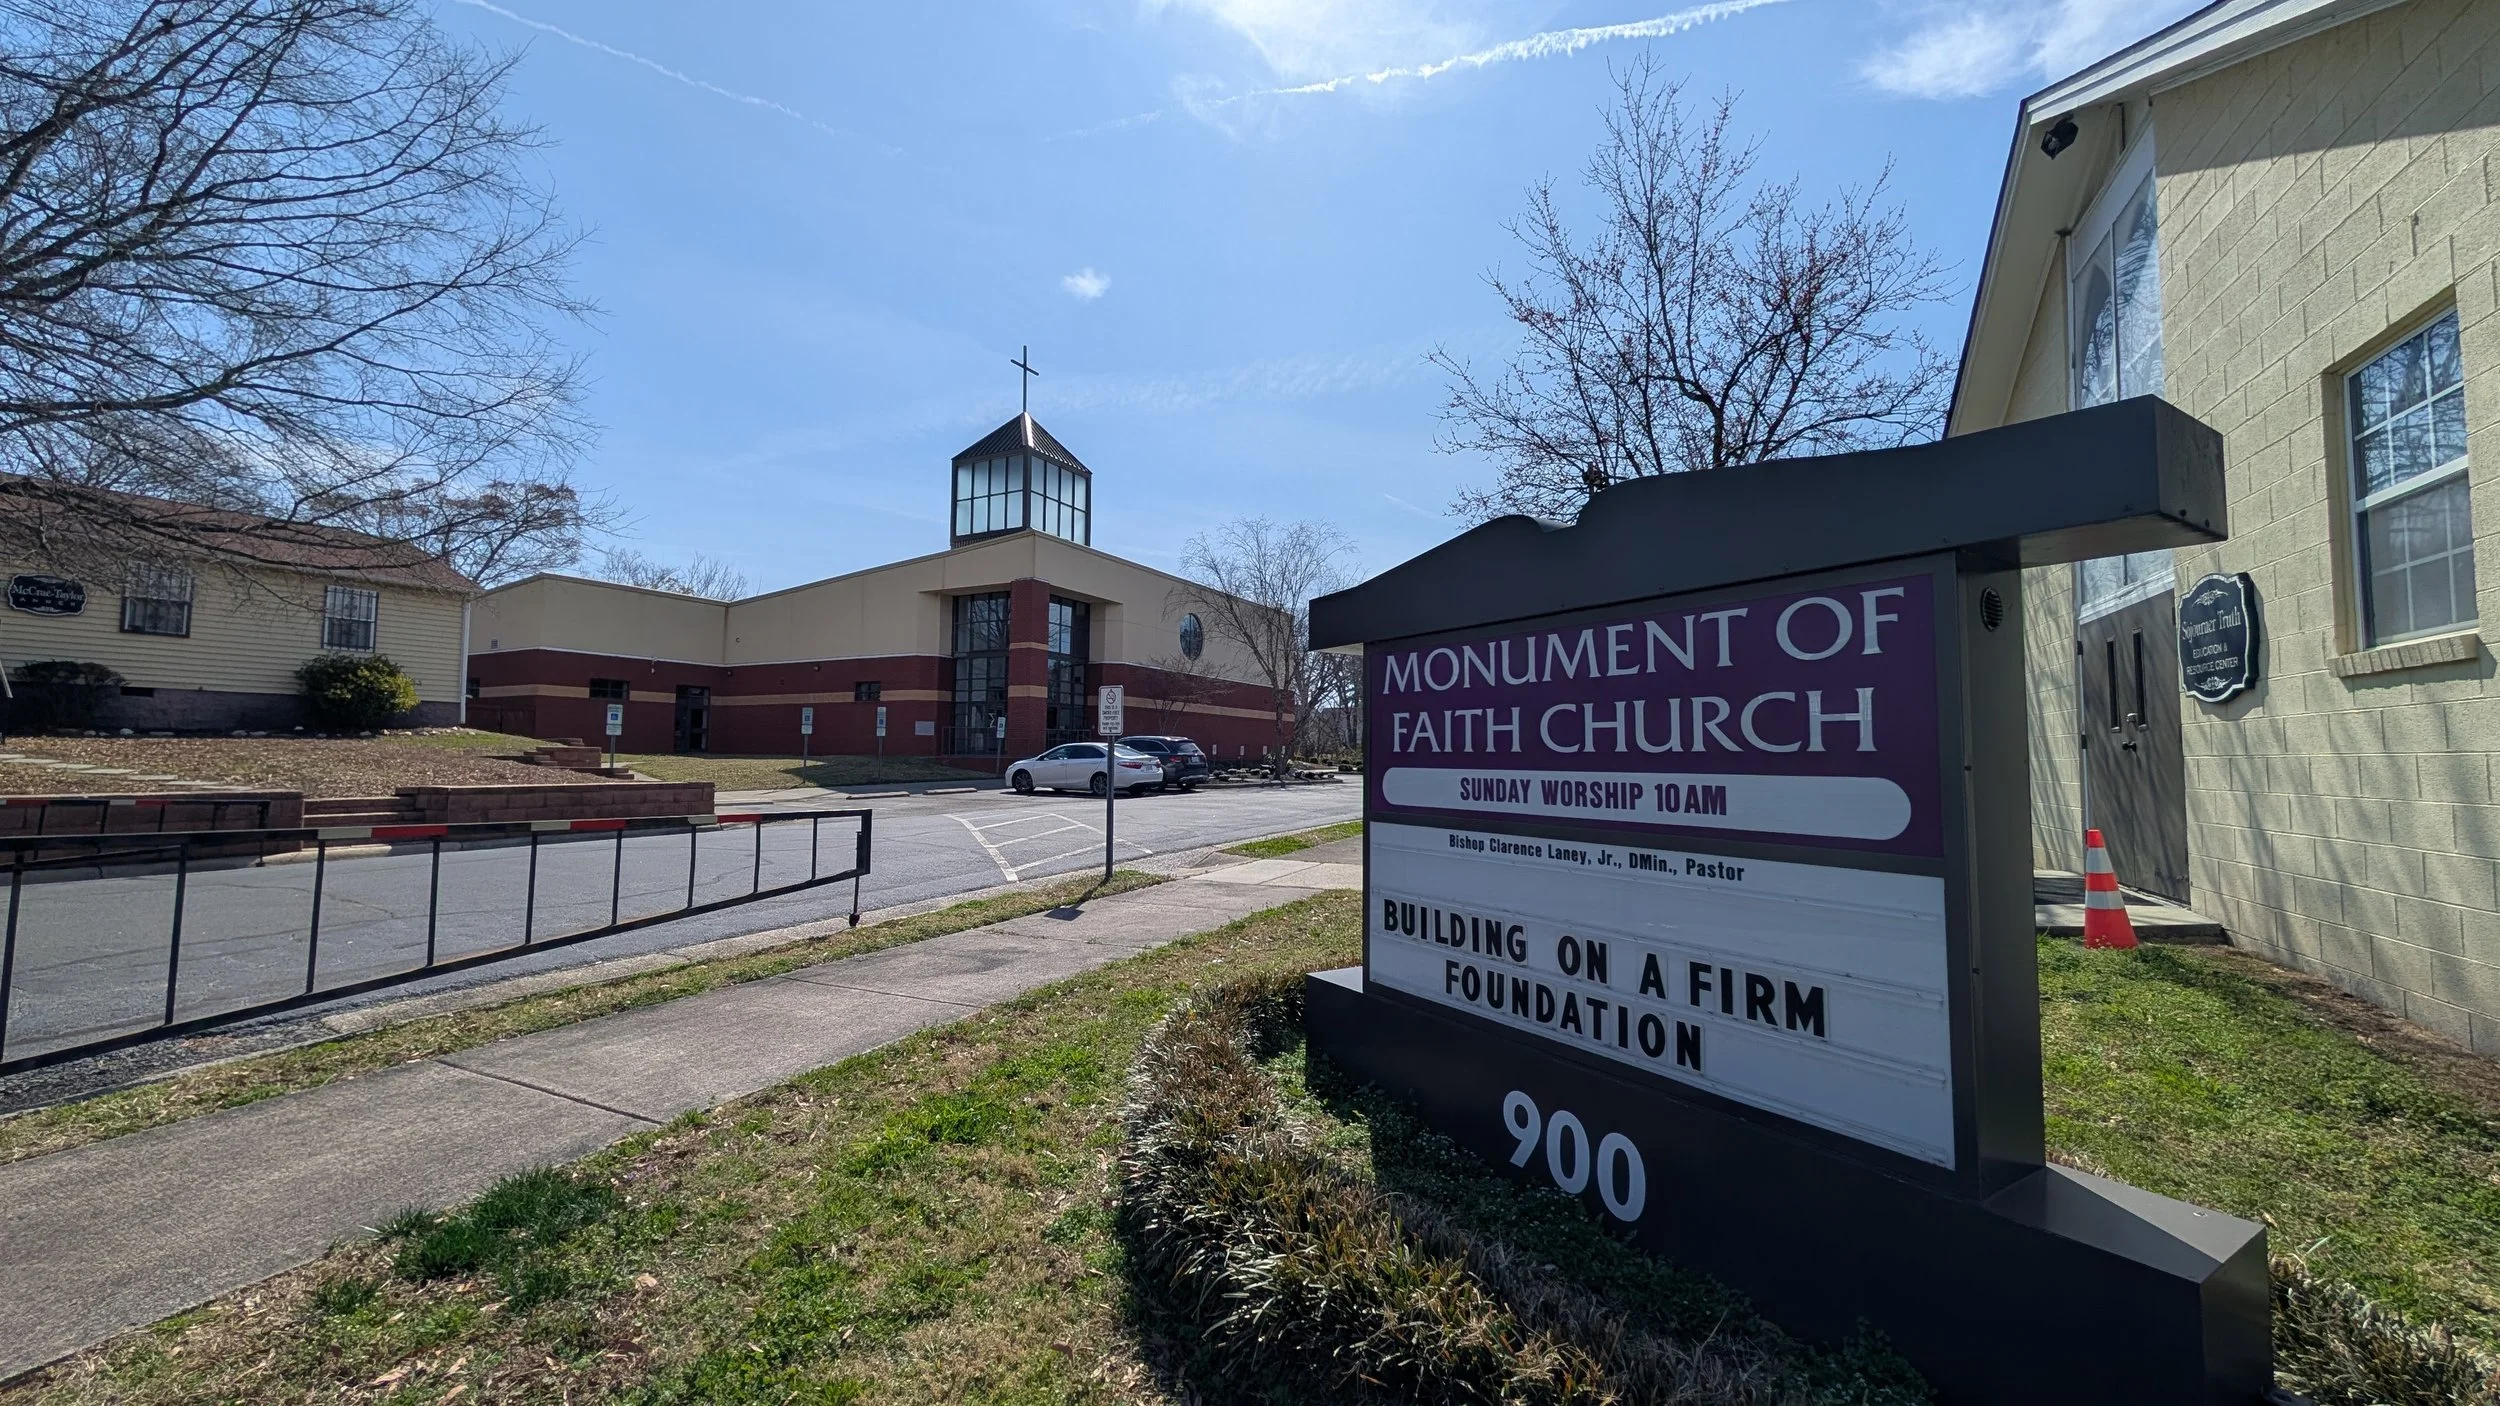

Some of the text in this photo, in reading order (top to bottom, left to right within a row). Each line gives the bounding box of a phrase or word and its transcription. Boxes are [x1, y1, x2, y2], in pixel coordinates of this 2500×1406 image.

[1383, 586, 1905, 695] MONUMENT OF
[2217, 606, 2242, 630] Truth
[2215, 656, 2239, 671] CENTER
[1392, 687, 1878, 753] FAITH CHURCH
[1460, 777, 1531, 804] SUNDAY
[1541, 780, 1643, 811] WORSHIP
[1449, 834, 1745, 882] Bishop Clarence Laney, Jr., DMin., Pastor
[1383, 899, 1826, 1038] BUILDING ON A FIRM
[1445, 960, 1702, 1072] FOUNDATION
[1503, 1090, 1647, 1223] 900
